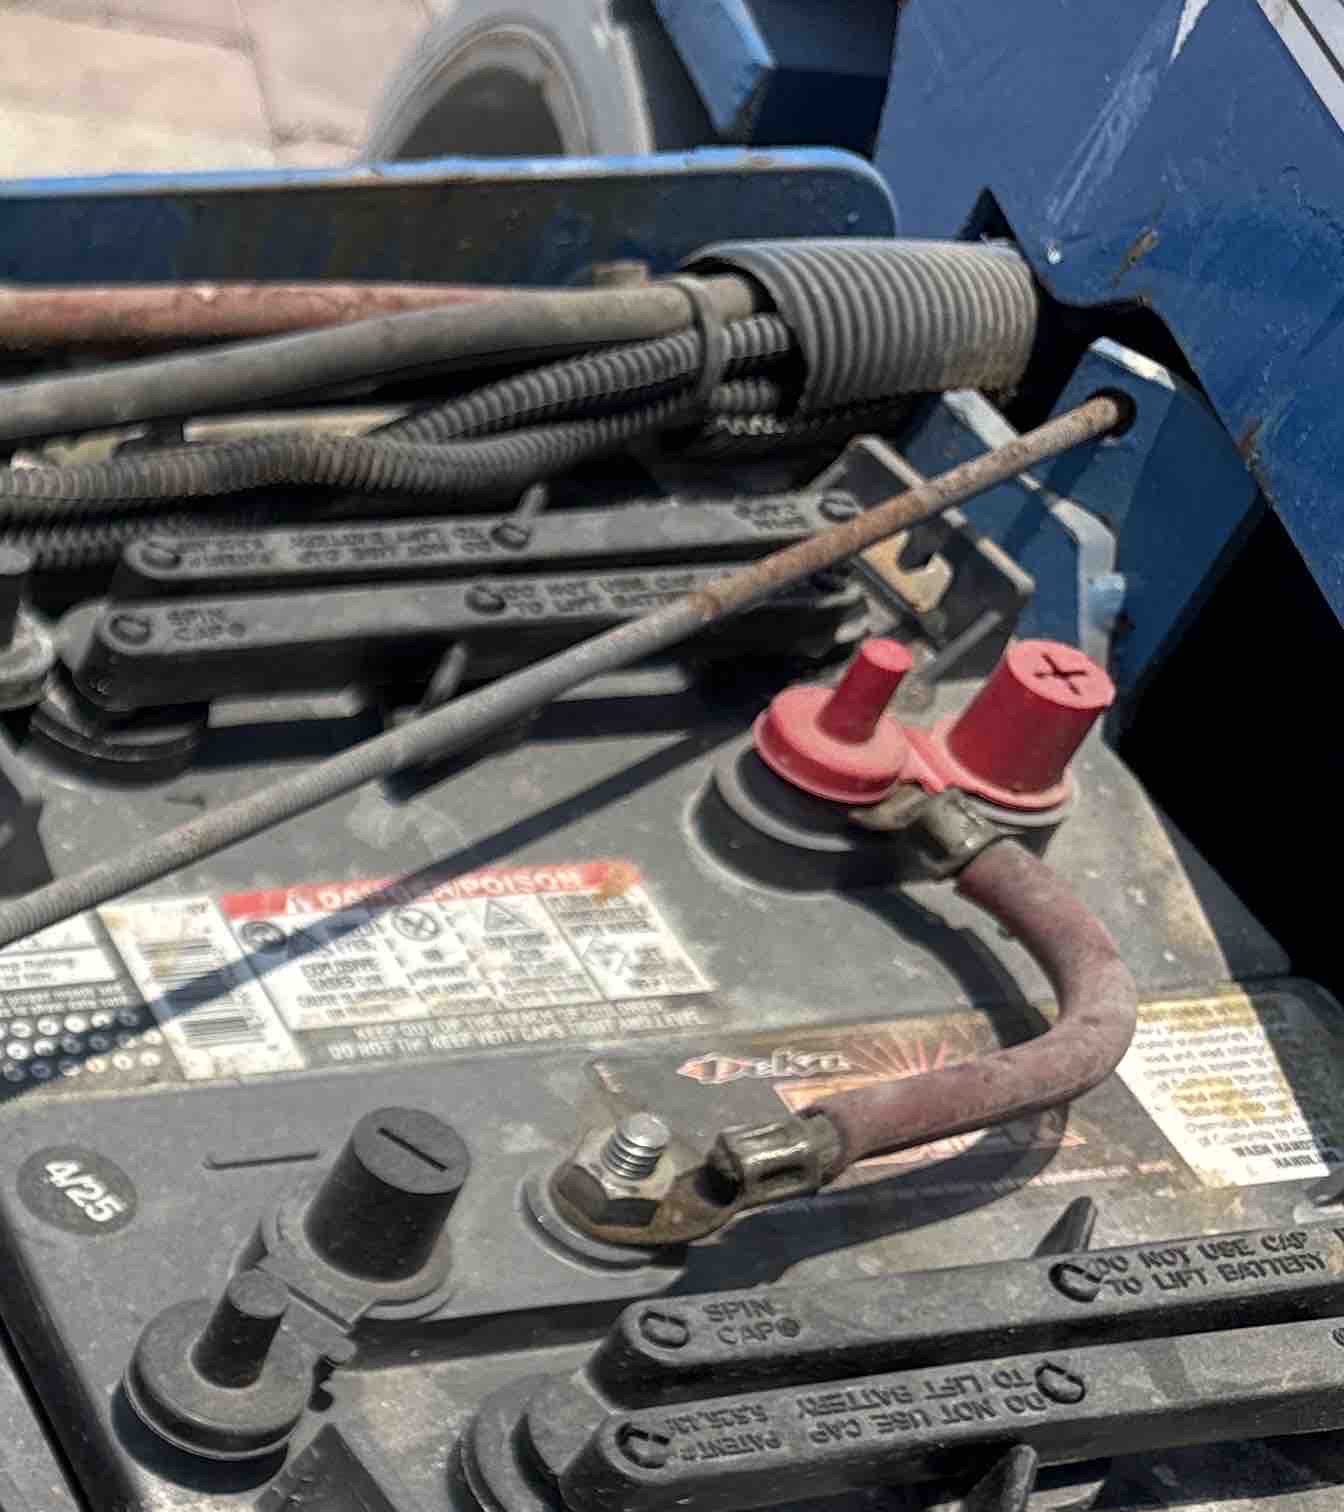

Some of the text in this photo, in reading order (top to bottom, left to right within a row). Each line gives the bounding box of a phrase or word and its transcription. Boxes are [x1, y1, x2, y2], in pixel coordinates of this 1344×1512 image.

[1107, 1250, 1325, 1298] TO LIFT BATTERY
[1142, 1246, 1191, 1271] NOT
[1200, 1238, 1250, 1262] USE
[1261, 1231, 1307, 1253] CAP
[700, 1296, 776, 1326] SPIN
[794, 1367, 1027, 1419] TO LIFT BATTERY
[805, 1391, 1042, 1445] DO NOT USE CAP
